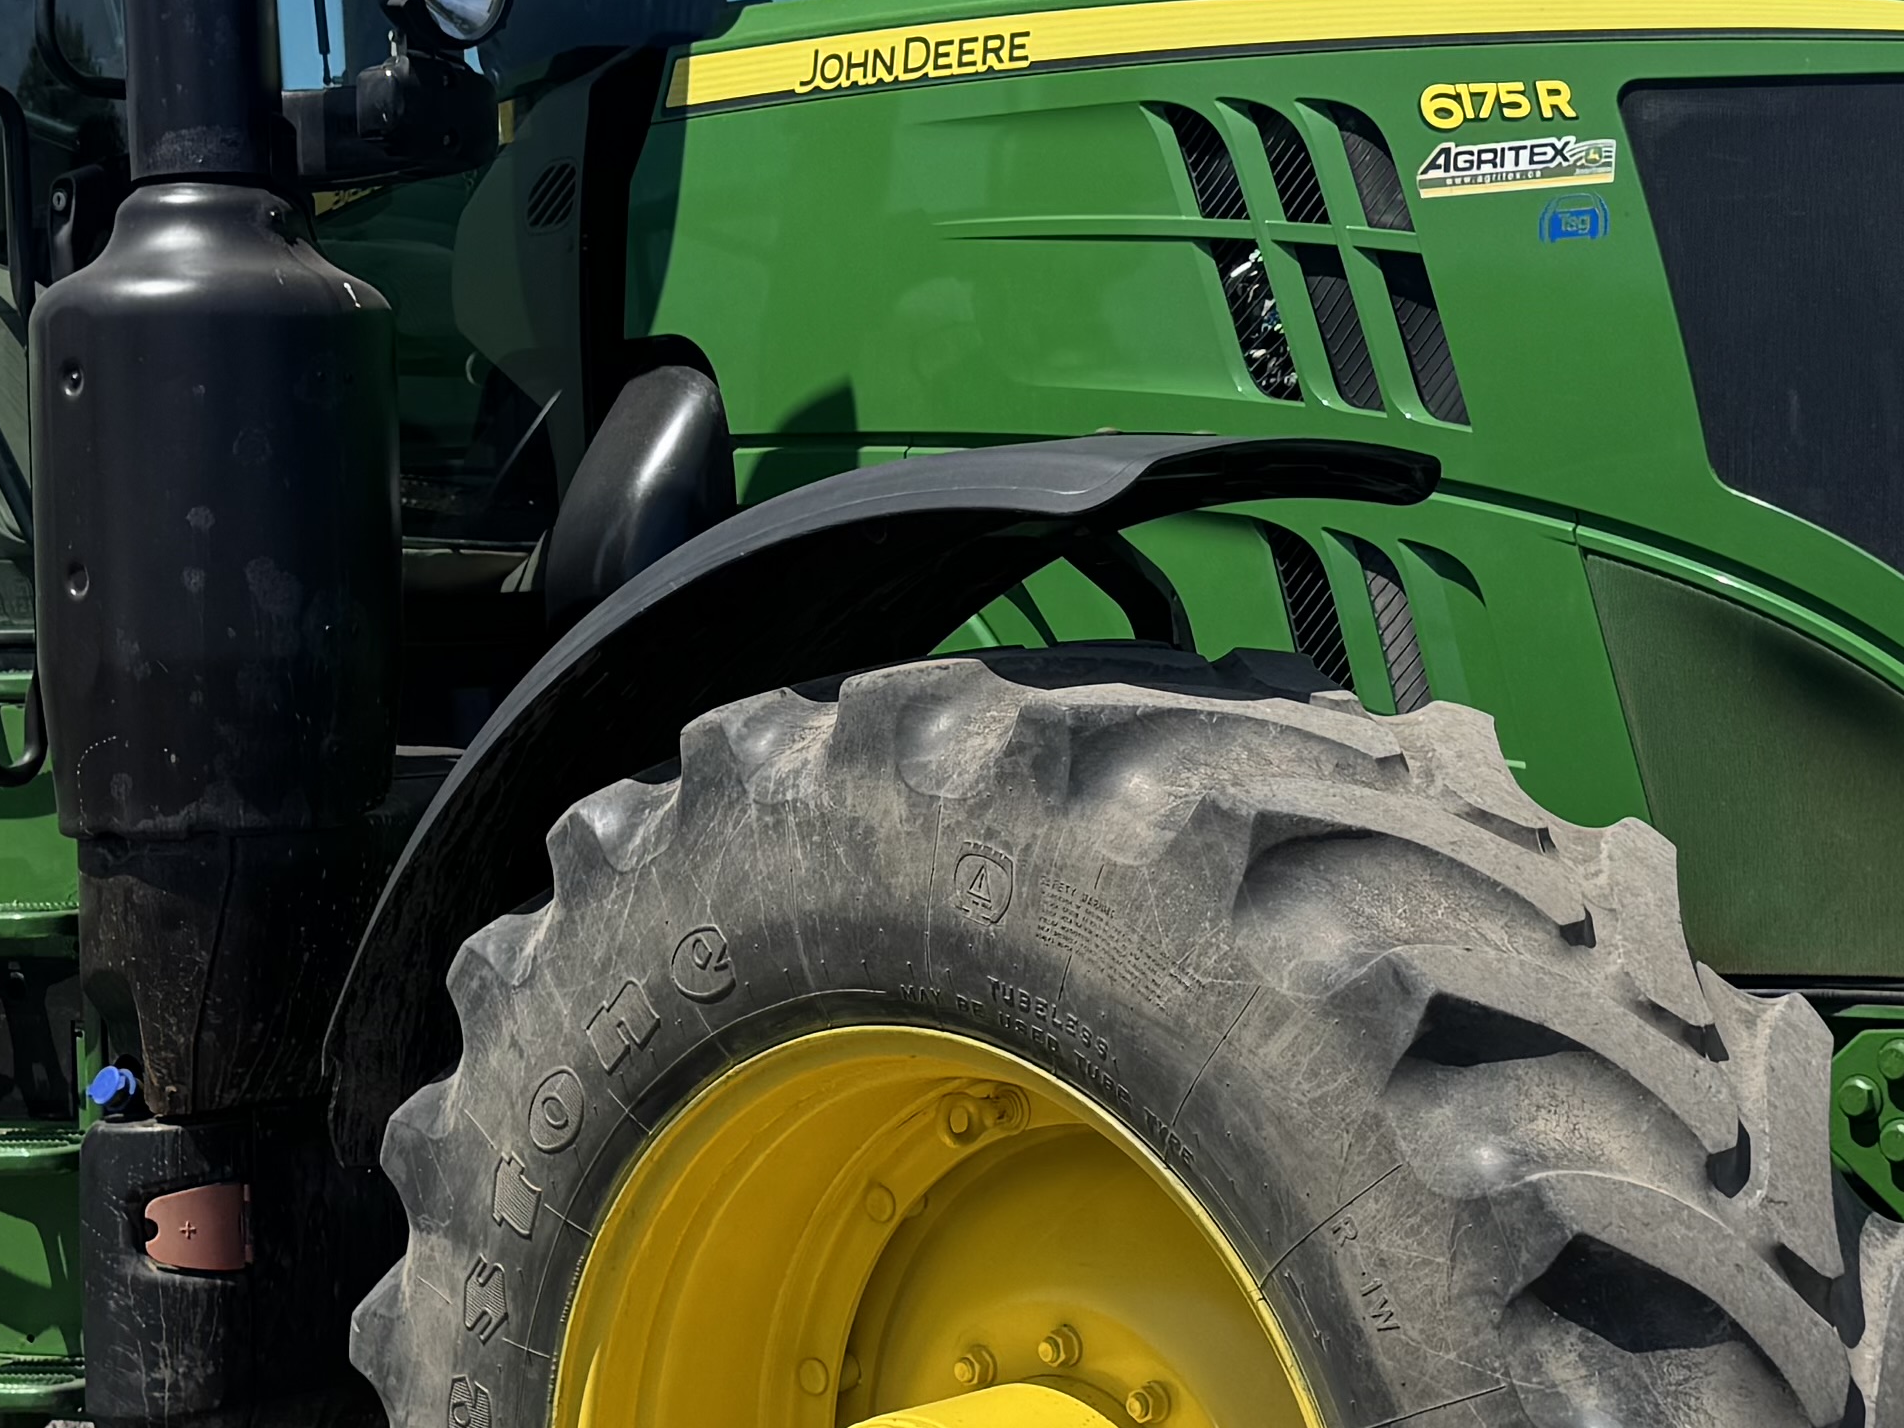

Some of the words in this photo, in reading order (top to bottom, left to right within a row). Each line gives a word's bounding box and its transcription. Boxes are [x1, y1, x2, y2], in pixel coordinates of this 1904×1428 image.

[799, 45, 896, 88] JOHN
[902, 31, 1031, 74] DEERE
[1419, 140, 1572, 176] AGRITEX
[899, 983, 942, 1005] MAY
[955, 993, 985, 1019] BE
[1073, 1049, 1135, 1110] TUBE
[987, 975, 1109, 1061] TUBELESS
